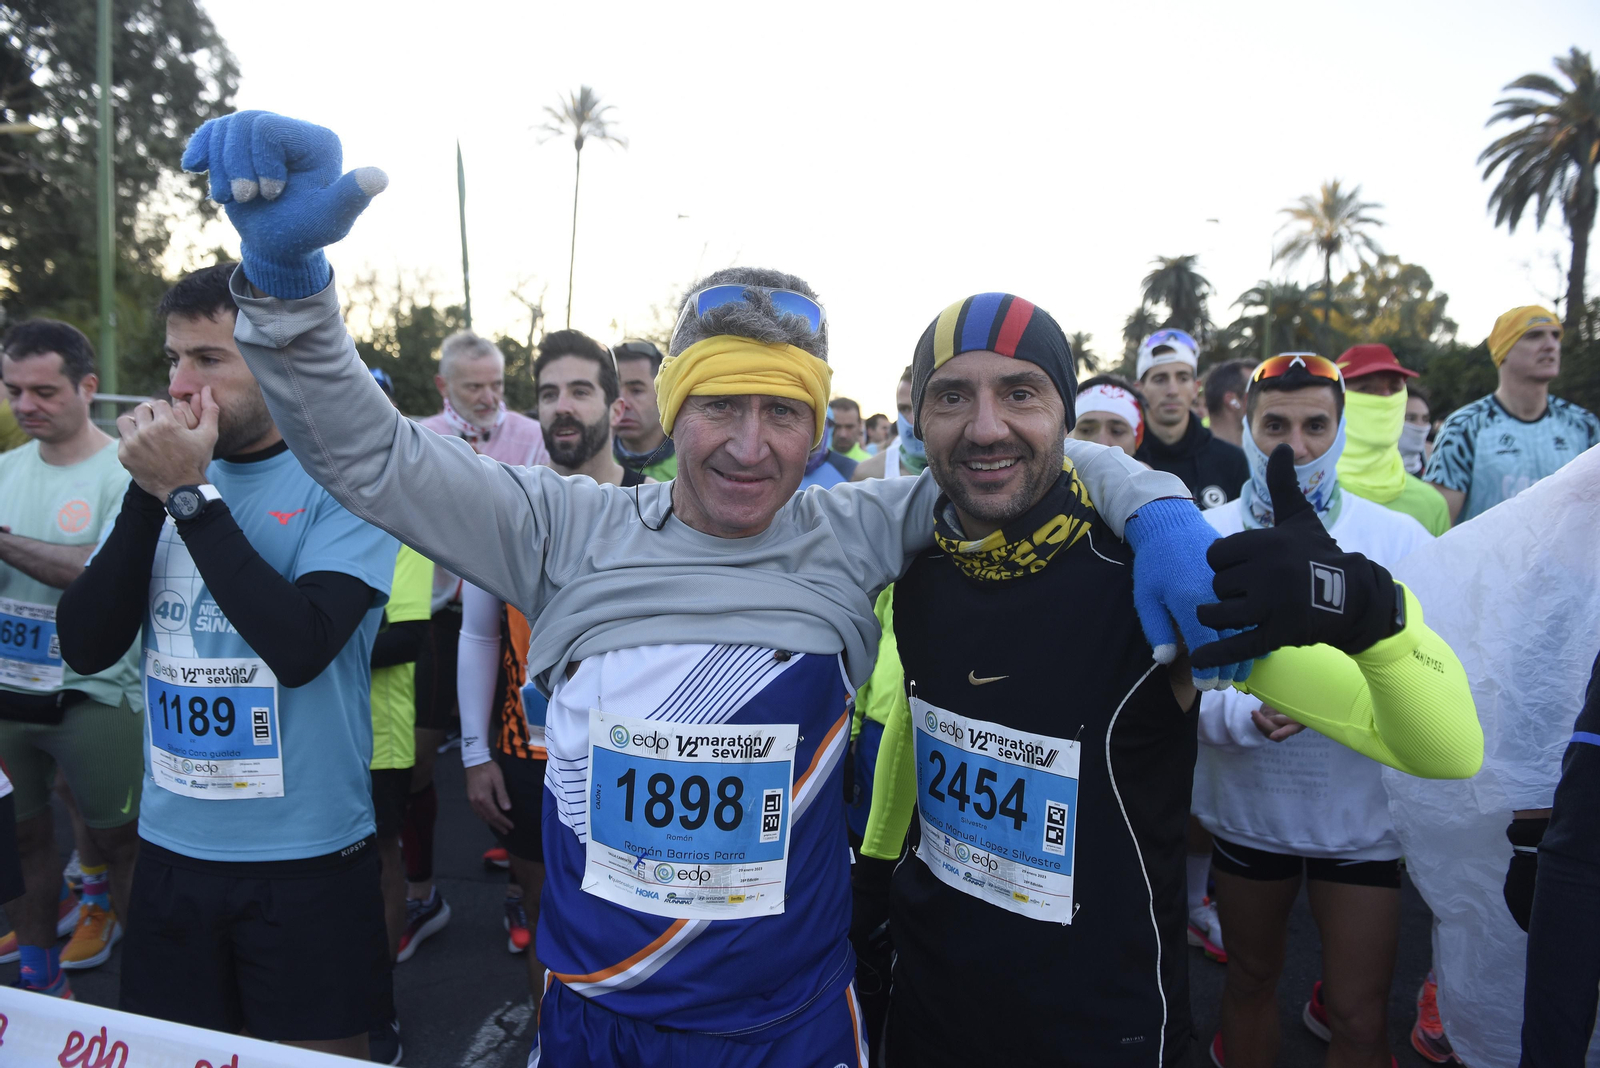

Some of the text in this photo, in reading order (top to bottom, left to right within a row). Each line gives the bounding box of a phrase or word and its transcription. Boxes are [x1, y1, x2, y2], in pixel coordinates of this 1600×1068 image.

[155, 601, 185, 622] 40
[199, 604, 223, 617] NIC
[2, 620, 41, 651] 681
[162, 664, 178, 681] edp
[194, 666, 247, 676] maratón
[207, 674, 248, 684] sevilla
[159, 690, 236, 738] 1189
[632, 731, 669, 754] edp
[697, 734, 762, 747] maratón
[940, 720, 964, 742] edp
[985, 731, 1044, 756] maratón
[711, 745, 762, 758] sevilla
[998, 746, 1046, 767] sevilla
[195, 760, 218, 776] edp
[616, 767, 744, 831] 1898
[928, 750, 1028, 831] 2454
[960, 816, 988, 831] Silvestre
[666, 833, 693, 842] Román
[945, 822, 977, 843] Manuel
[980, 837, 1008, 857] Lopez
[1012, 849, 1061, 870] Silvestre
[340, 840, 367, 857] KIPSTA
[624, 840, 745, 861] Román Barrios Parra
[942, 861, 960, 877] HOKA
[971, 853, 998, 873] edp
[677, 865, 711, 886] edp
[635, 887, 660, 900] HOKA
